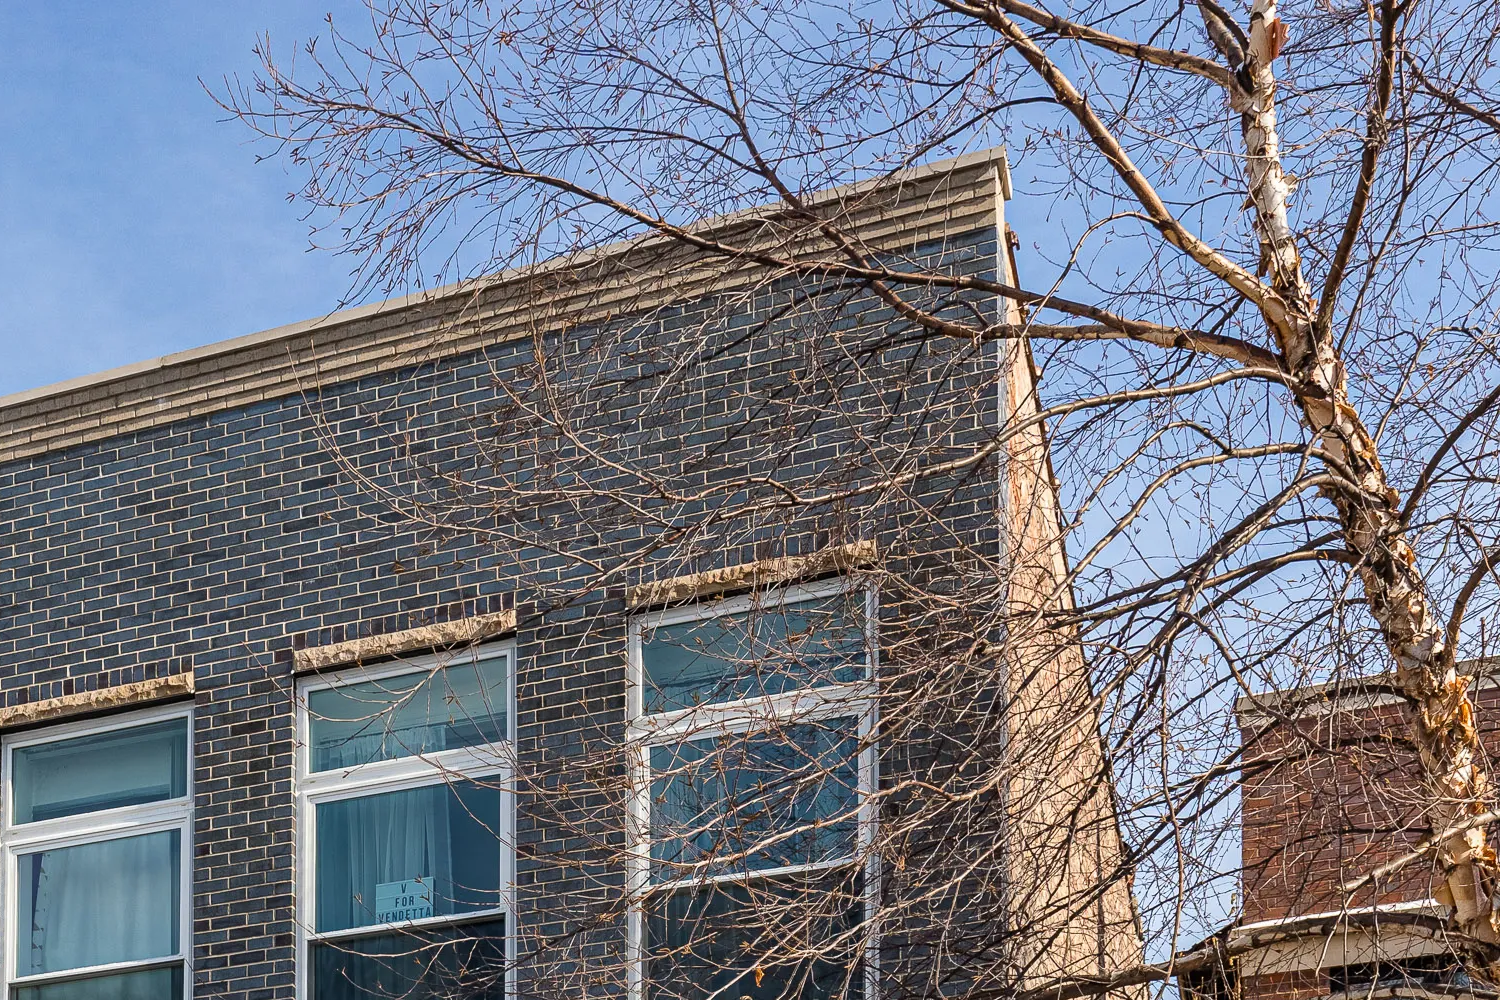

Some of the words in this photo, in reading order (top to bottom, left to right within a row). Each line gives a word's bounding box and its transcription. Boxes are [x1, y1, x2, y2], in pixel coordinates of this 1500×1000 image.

[400, 883, 407, 894] V
[395, 895, 415, 908] FOR
[377, 906, 431, 923] VENDETTA
